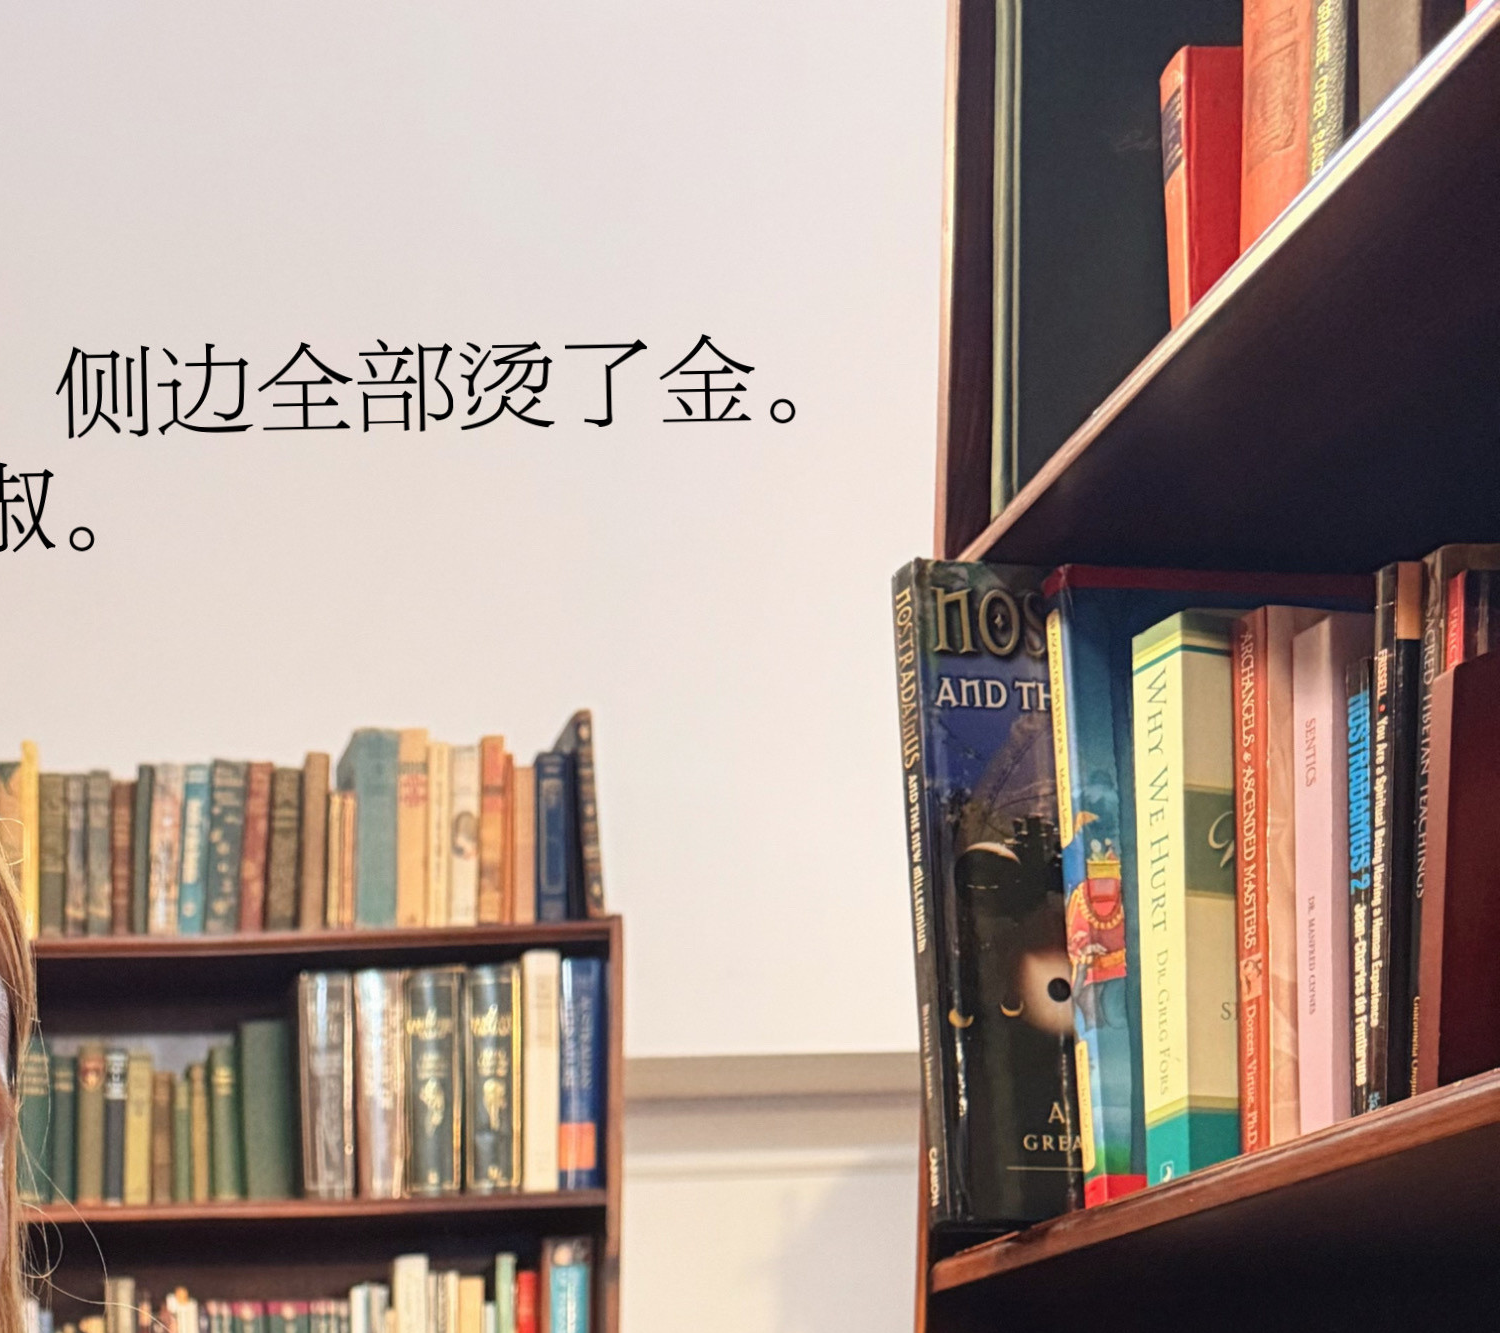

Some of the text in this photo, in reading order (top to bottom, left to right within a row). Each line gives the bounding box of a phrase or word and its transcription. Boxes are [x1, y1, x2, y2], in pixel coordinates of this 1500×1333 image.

[935, 676, 1052, 712] AND TH
[1241, 631, 1256, 748] ARCHANGELS
[1375, 714, 1389, 742] You
[1305, 717, 1317, 788] SENTICS
[1375, 743, 1388, 765] Are
[907, 774, 920, 805] AND
[1147, 667, 1170, 932] WHY WE HURT
[1374, 773, 1388, 827] Spiritual
[909, 806, 921, 836] THE
[1243, 765, 1257, 861] ASCENDED
[1372, 827, 1386, 862] Being
[1350, 874, 1371, 895] 2
[1371, 862, 1383, 911] Having
[1243, 864, 1258, 950] MASTERS
[1354, 903, 1368, 994] Jean-Charles
[1371, 919, 1384, 959] Human
[1355, 995, 1367, 1012] de
[1370, 959, 1384, 1028] Experience
[1157, 987, 1170, 1051] GREG
[1245, 1004, 1258, 1058] Doreen
[1047, 1101, 1066, 1125] A
[1023, 1132, 1082, 1152] GREA
